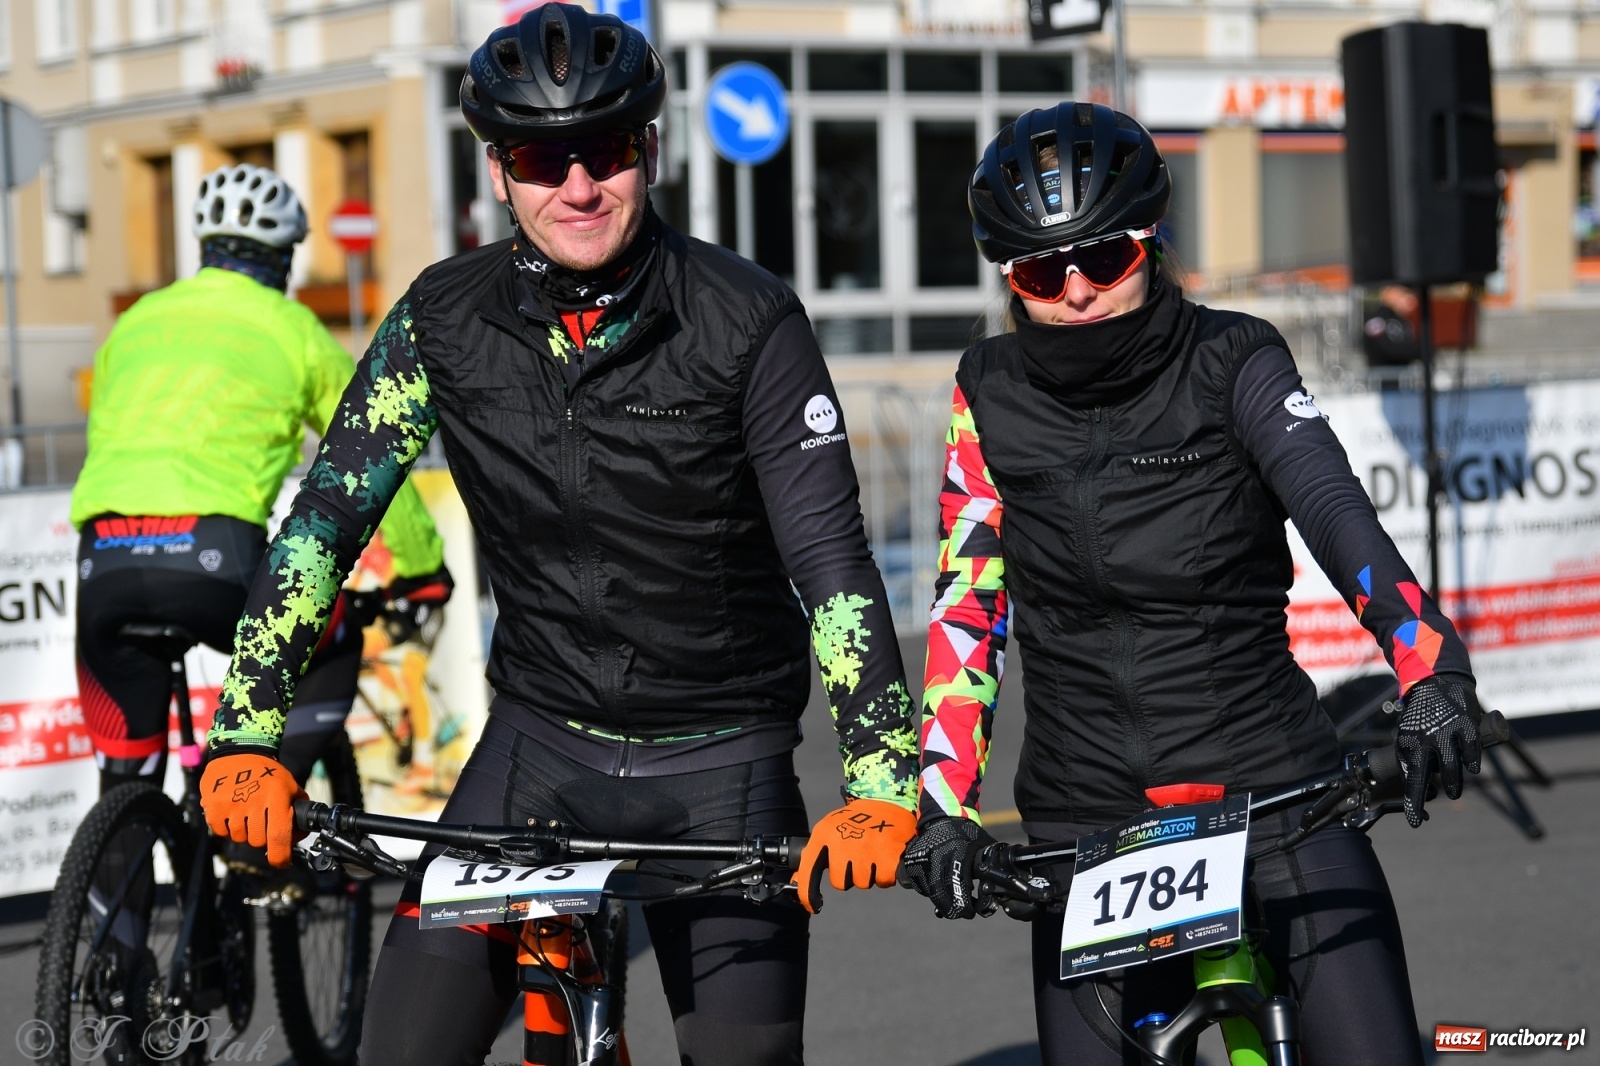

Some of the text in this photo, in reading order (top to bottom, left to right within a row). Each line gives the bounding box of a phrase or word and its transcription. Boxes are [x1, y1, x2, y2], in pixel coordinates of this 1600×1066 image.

[211, 766, 278, 794] FOX
[830, 809, 895, 833] FOX
[952, 860, 965, 908] CHIBA
[1092, 858, 1209, 927] 1784
[1149, 934, 1174, 947] CST
